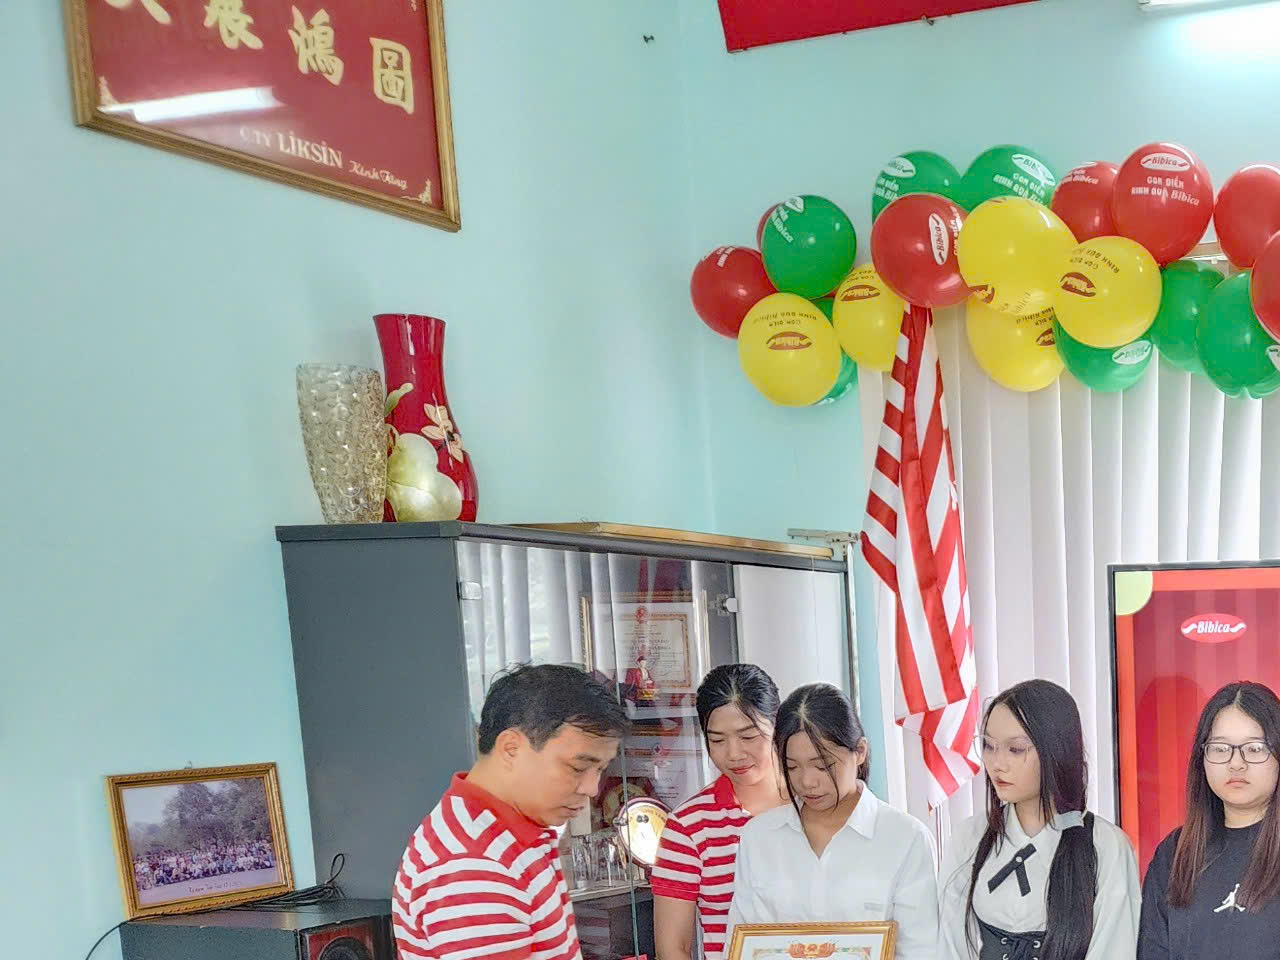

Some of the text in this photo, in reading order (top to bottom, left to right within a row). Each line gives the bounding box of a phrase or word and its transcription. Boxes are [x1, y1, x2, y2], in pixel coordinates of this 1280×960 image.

[1152, 156, 1178, 166] Bibica
[1171, 190, 1200, 206] Bibica
[935, 226, 945, 252] Bibica
[1099, 257, 1121, 274] RINH
[1197, 620, 1230, 633] Bibica
